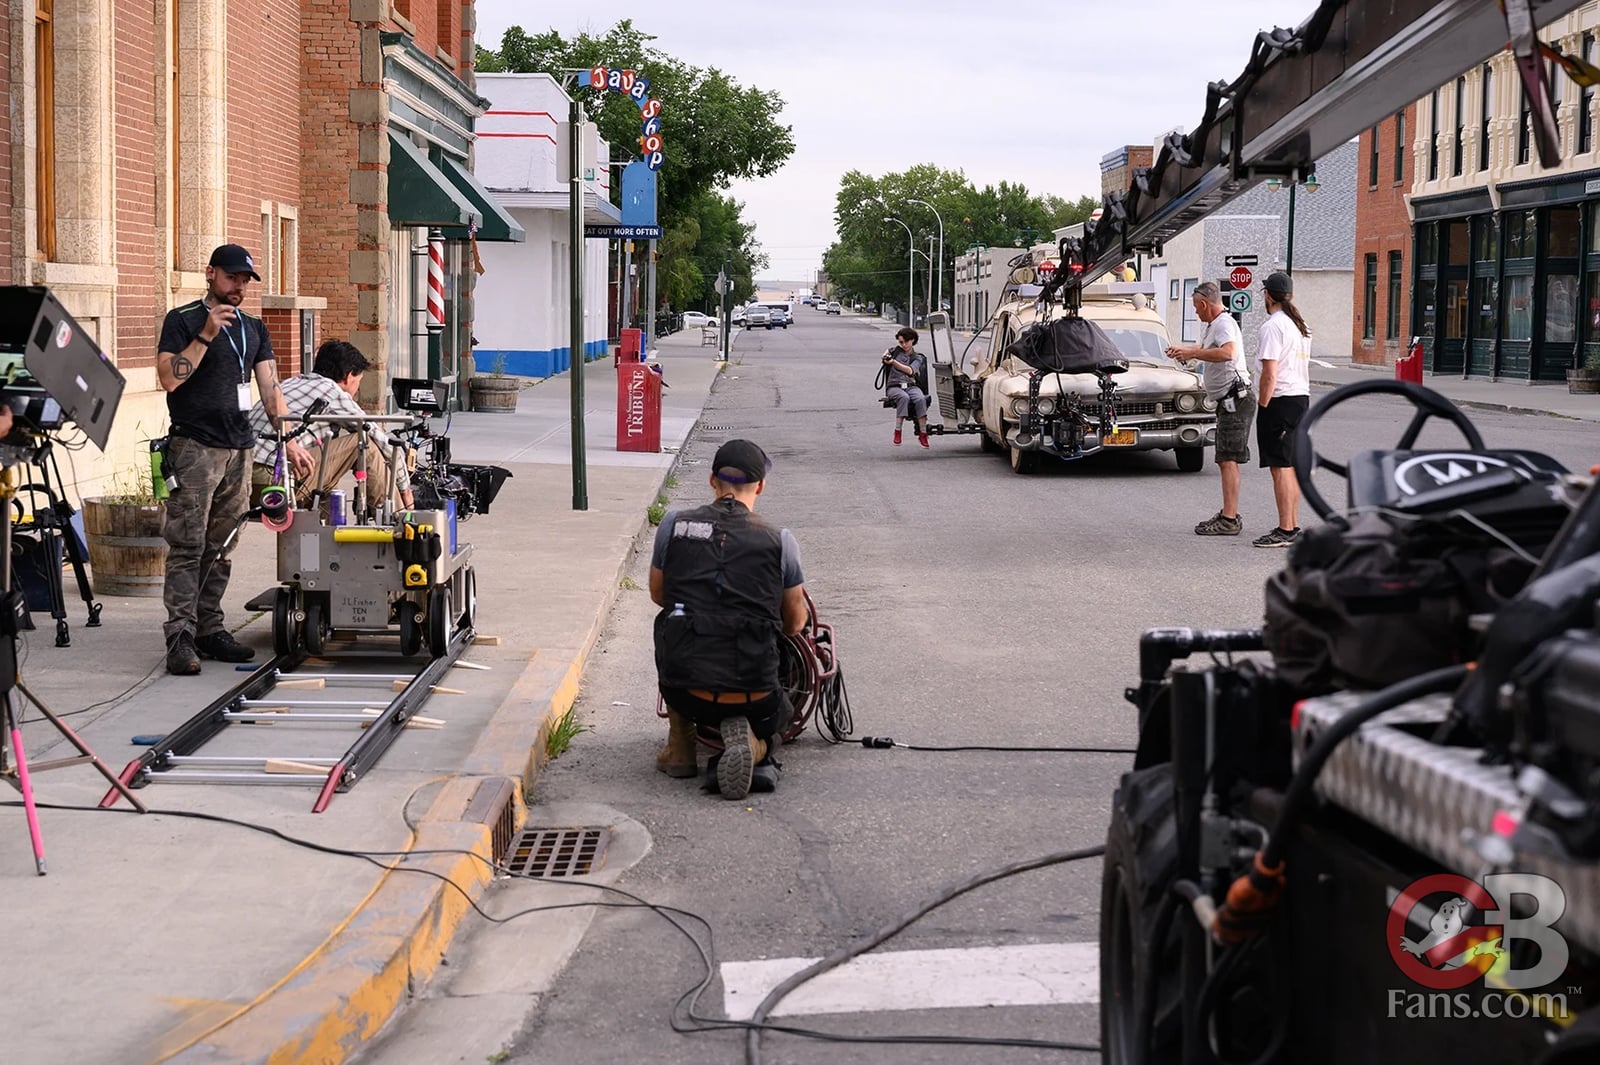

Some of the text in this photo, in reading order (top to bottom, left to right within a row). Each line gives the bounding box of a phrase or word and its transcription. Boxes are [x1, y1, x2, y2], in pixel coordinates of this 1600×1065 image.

[593, 67, 646, 99] Java
[614, 228, 634, 236] MORE
[636, 228, 659, 236] OFTEN
[1232, 274, 1251, 282] STOP
[628, 370, 645, 437] TRIBUNE
